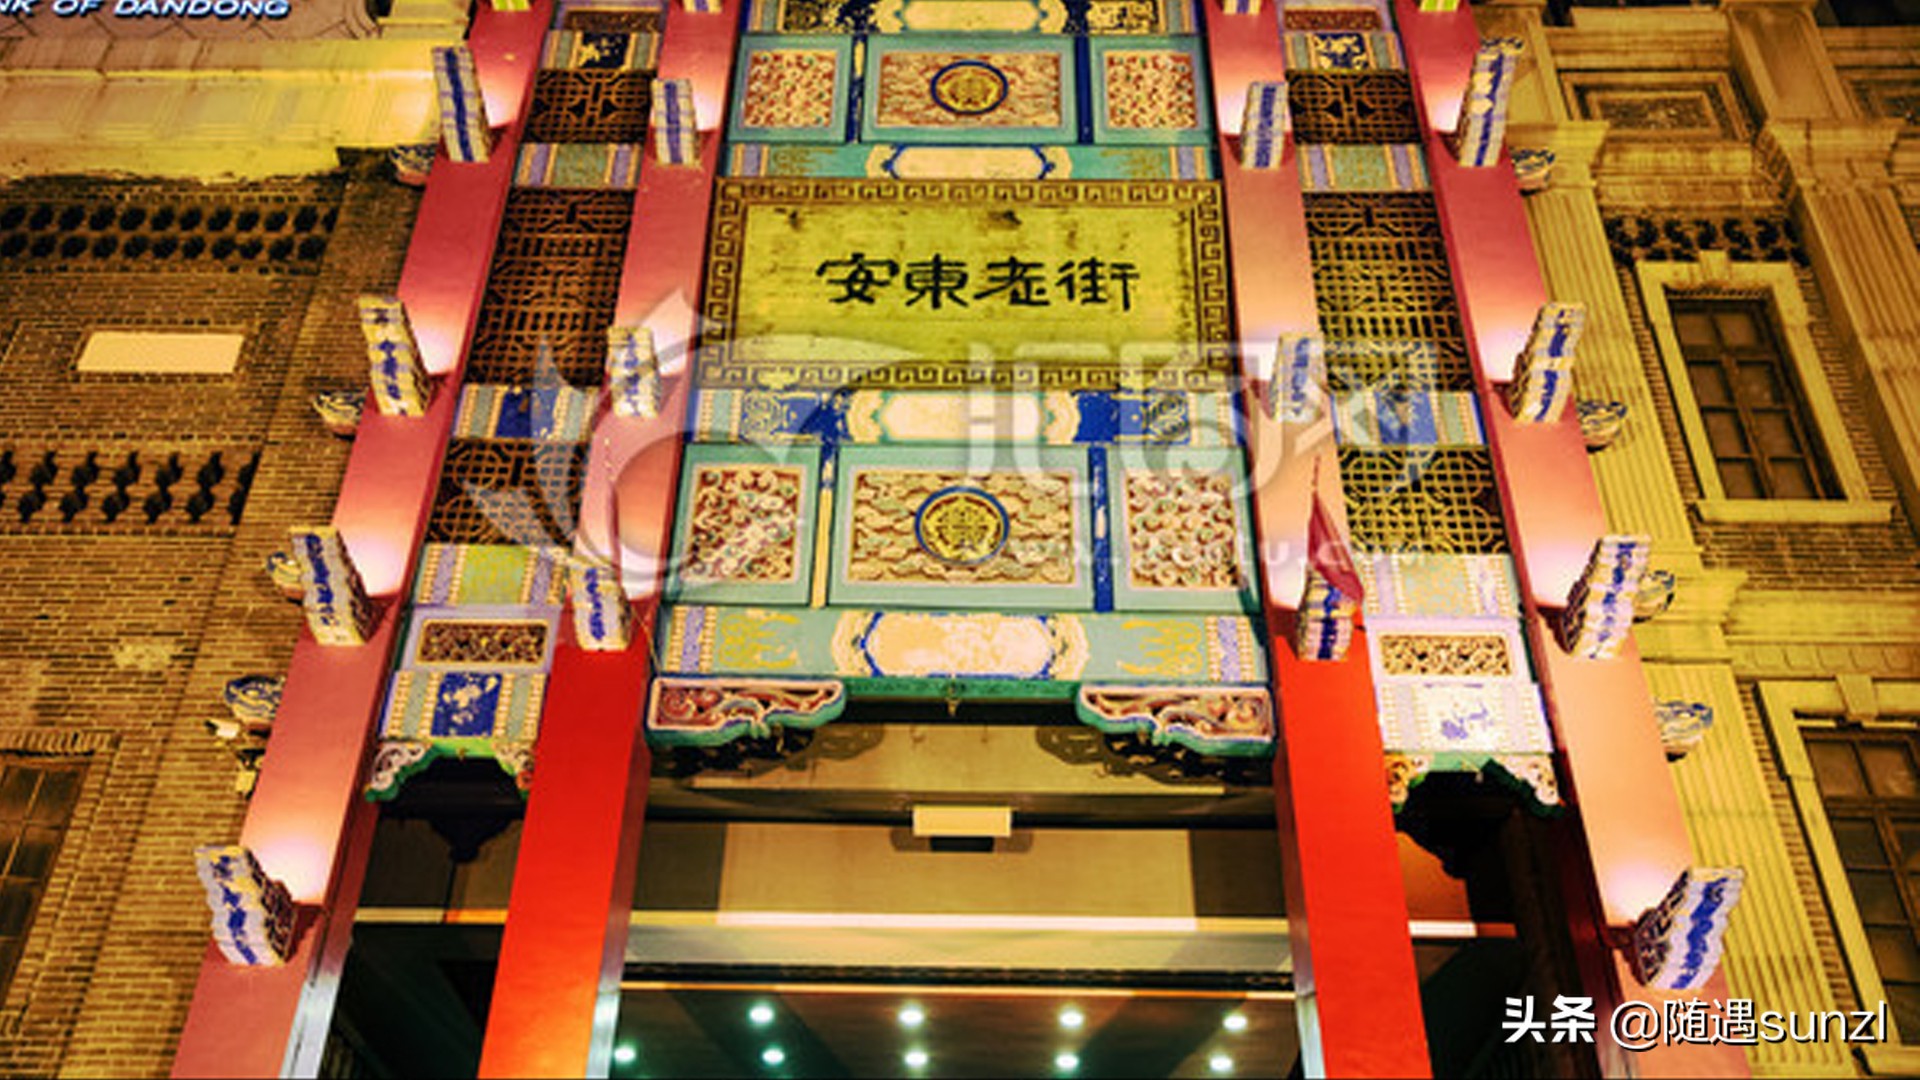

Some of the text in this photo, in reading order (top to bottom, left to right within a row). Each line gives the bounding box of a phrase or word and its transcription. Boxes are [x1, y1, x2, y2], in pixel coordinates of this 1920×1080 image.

[52, 0, 103, 13] OF
[114, 0, 290, 16] DANDONG
[815, 251, 1141, 311] 安東老街
